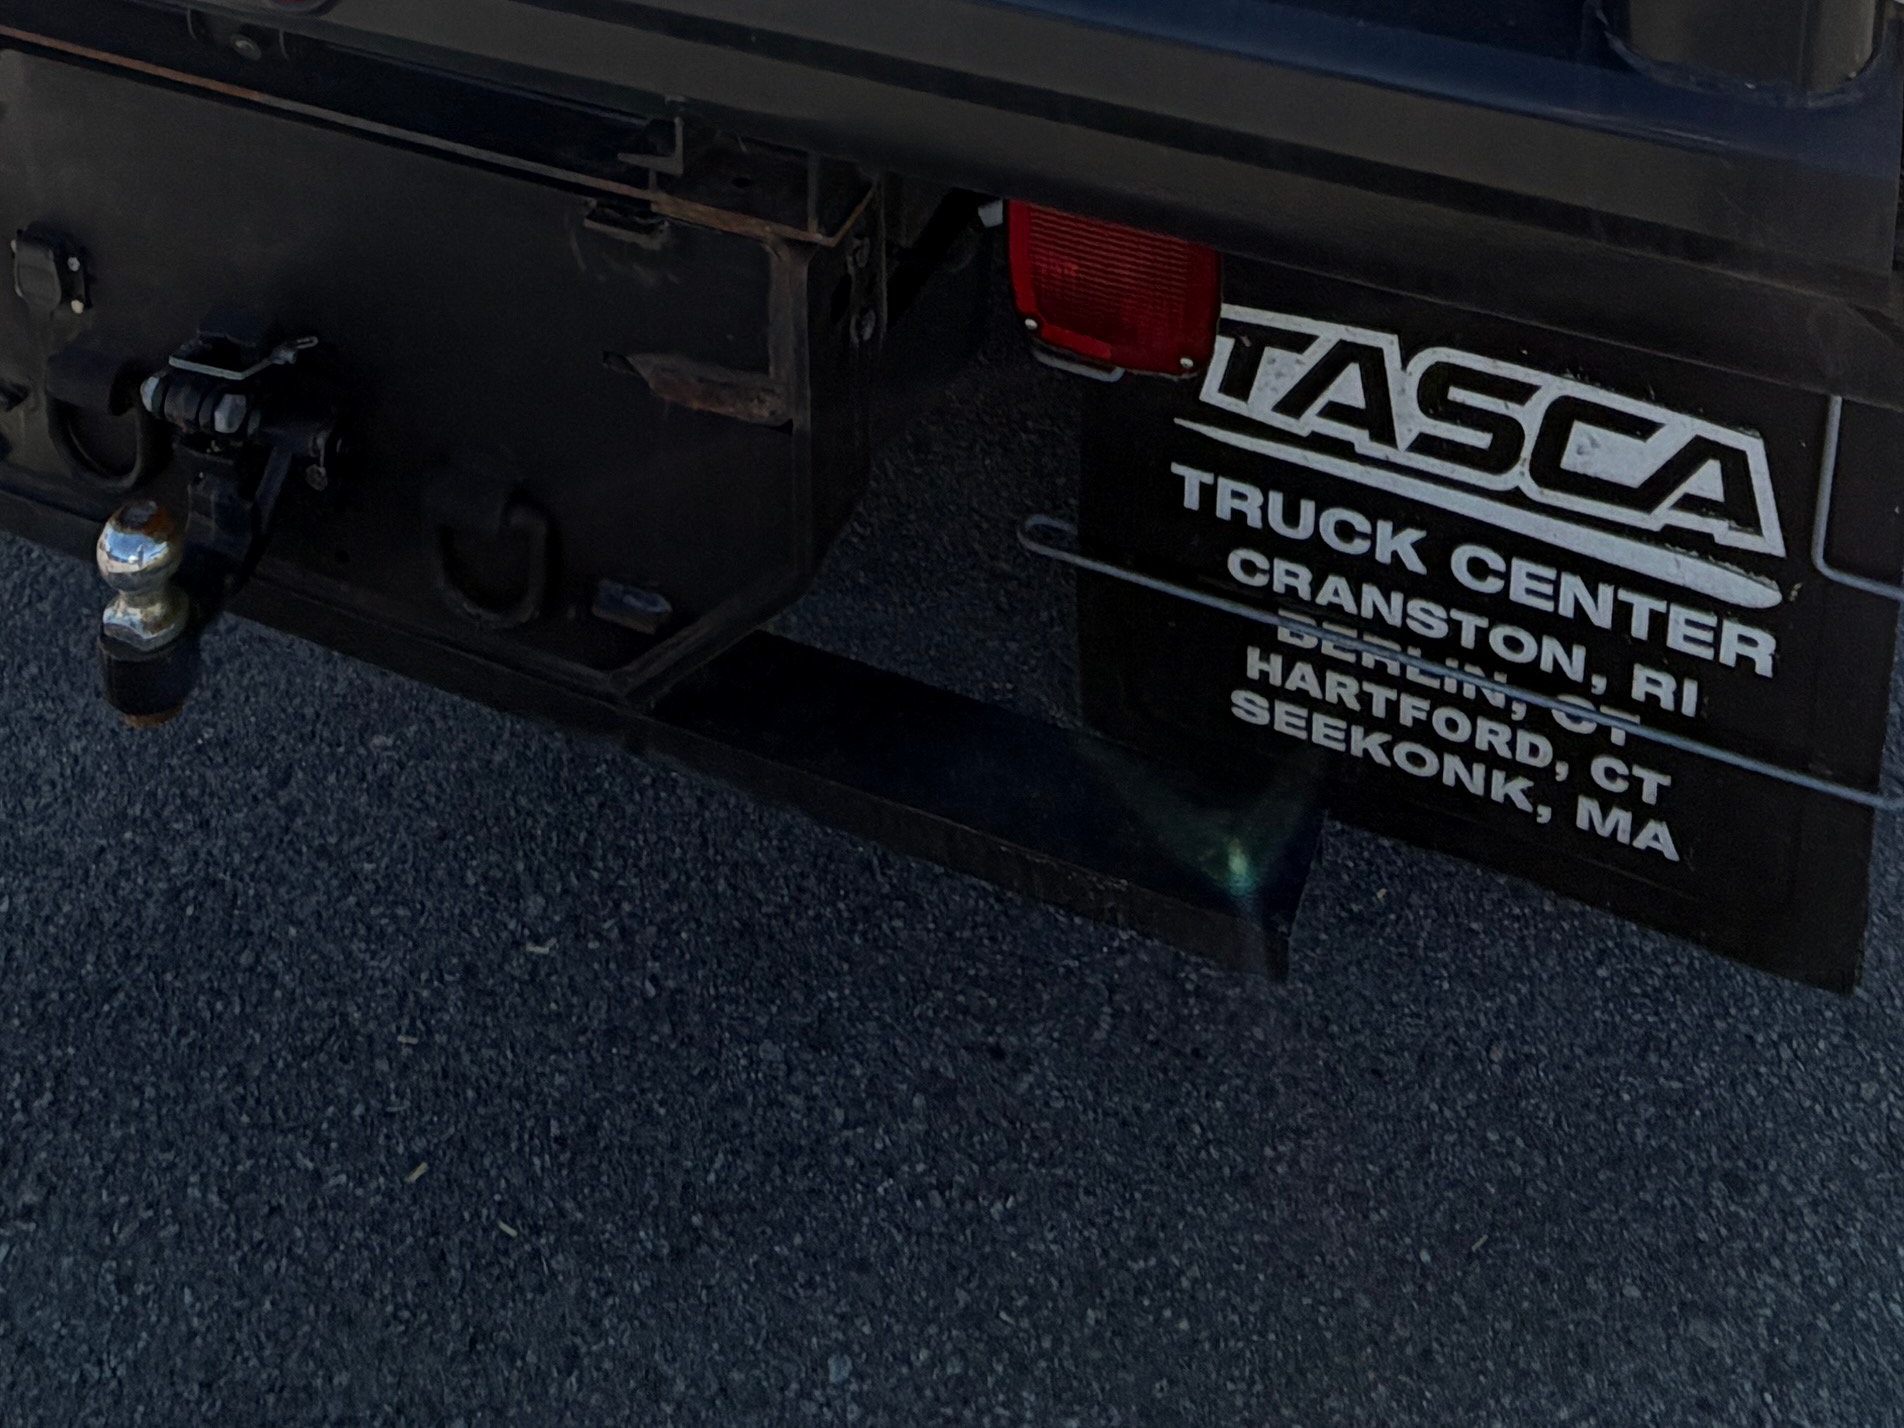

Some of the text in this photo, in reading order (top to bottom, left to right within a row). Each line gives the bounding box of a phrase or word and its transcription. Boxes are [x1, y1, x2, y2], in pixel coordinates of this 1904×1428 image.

[1199, 304, 1787, 558] TASCA
[1170, 462, 1781, 679] TRUCK CENTER
[1227, 547, 1698, 718] CRANSTON, RI
[1230, 689, 1680, 862] SEEKONK, MA
[1246, 645, 1672, 806] HARTFORD, CT
